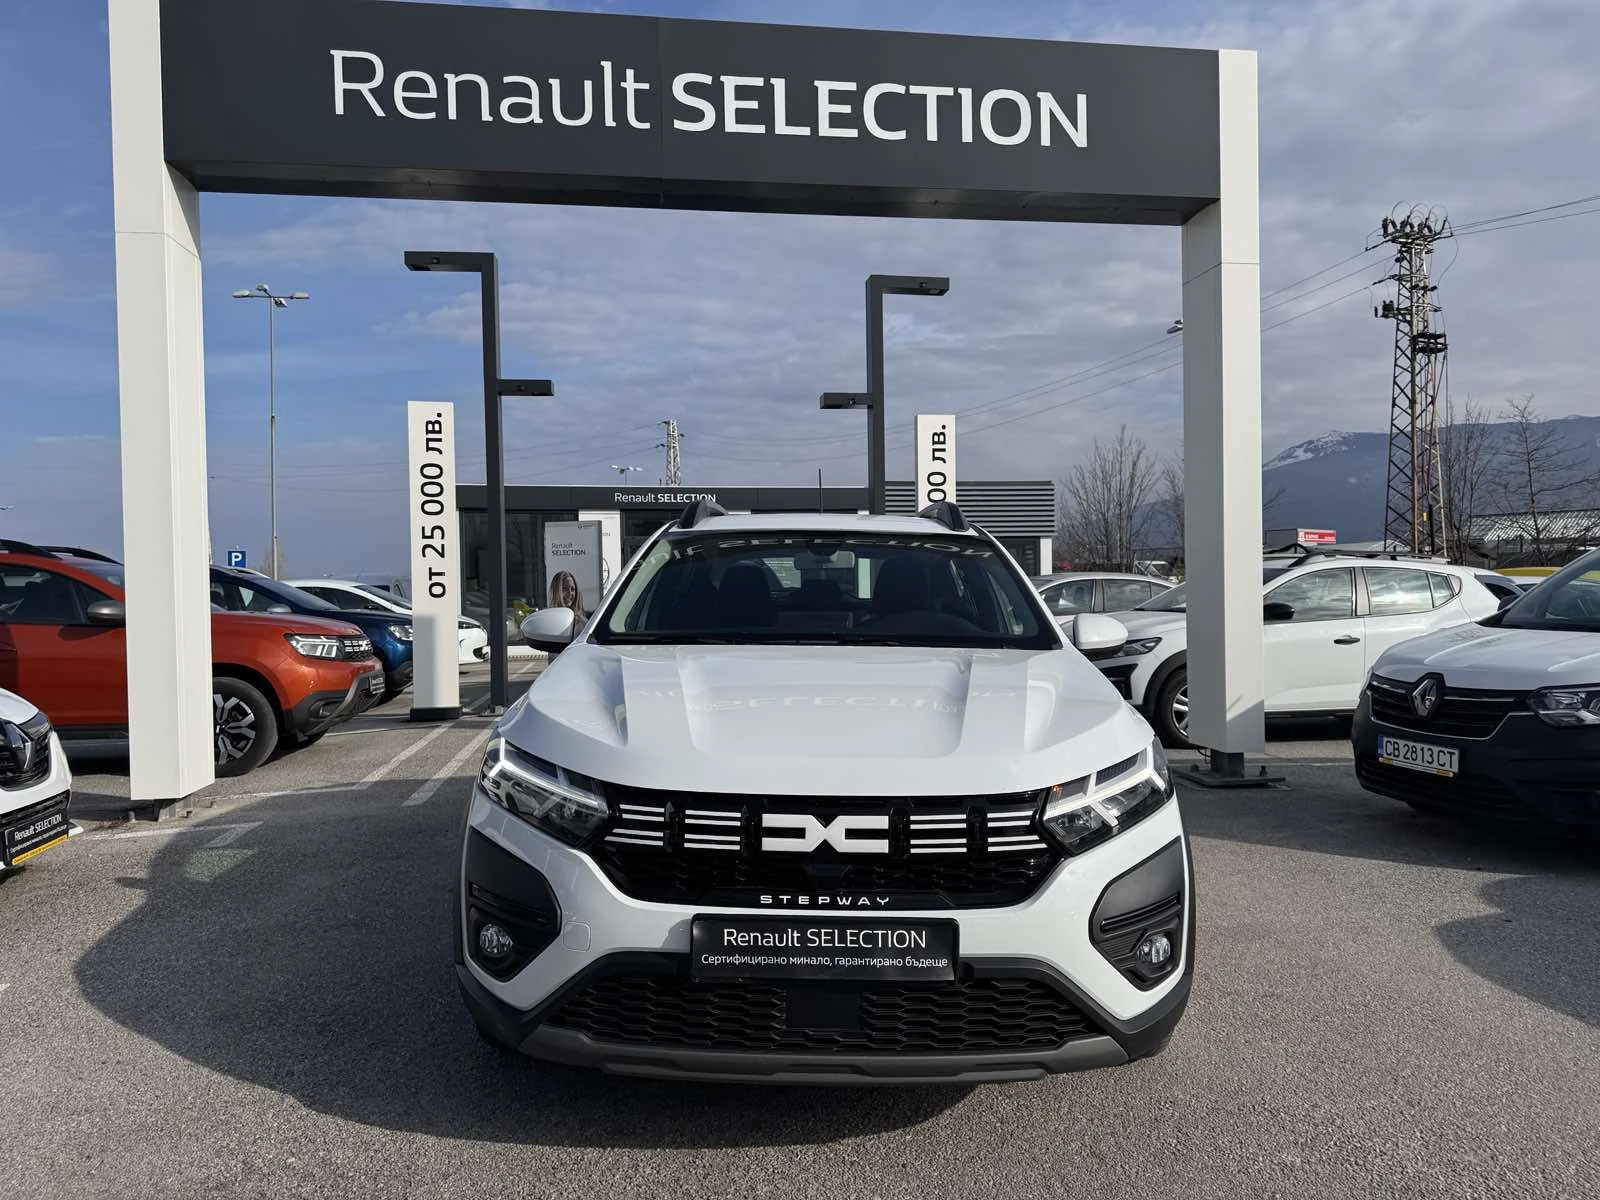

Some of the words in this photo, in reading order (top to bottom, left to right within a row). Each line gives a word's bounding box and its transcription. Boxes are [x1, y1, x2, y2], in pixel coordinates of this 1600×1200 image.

[330, 49, 651, 129] Renault
[672, 72, 1089, 148] SELECTION
[425, 412, 443, 455] лв.
[931, 424, 947, 464] лв.
[419, 462, 445, 516] 000
[614, 492, 655, 503] Renault
[657, 493, 717, 503] SELECTION
[421, 524, 445, 559] 25
[551, 549, 586, 557] SELECTION
[231, 552, 242, 566] P
[428, 566, 446, 598] от
[1385, 740, 1400, 758] CB
[1403, 743, 1434, 765] 2813
[1437, 750, 1456, 769] CT
[14, 824, 35, 841] Renault
[34, 813, 62, 833] SELECTION
[760, 895, 889, 906] STEPWAY
[723, 928, 801, 947] Renault
[806, 929, 926, 949] SELECTION
[701, 954, 787, 967] Сертифицирано
[789, 956, 832, 967] минало,
[834, 957, 903, 968] гарантирано
[905, 956, 948, 968] бъдеще
